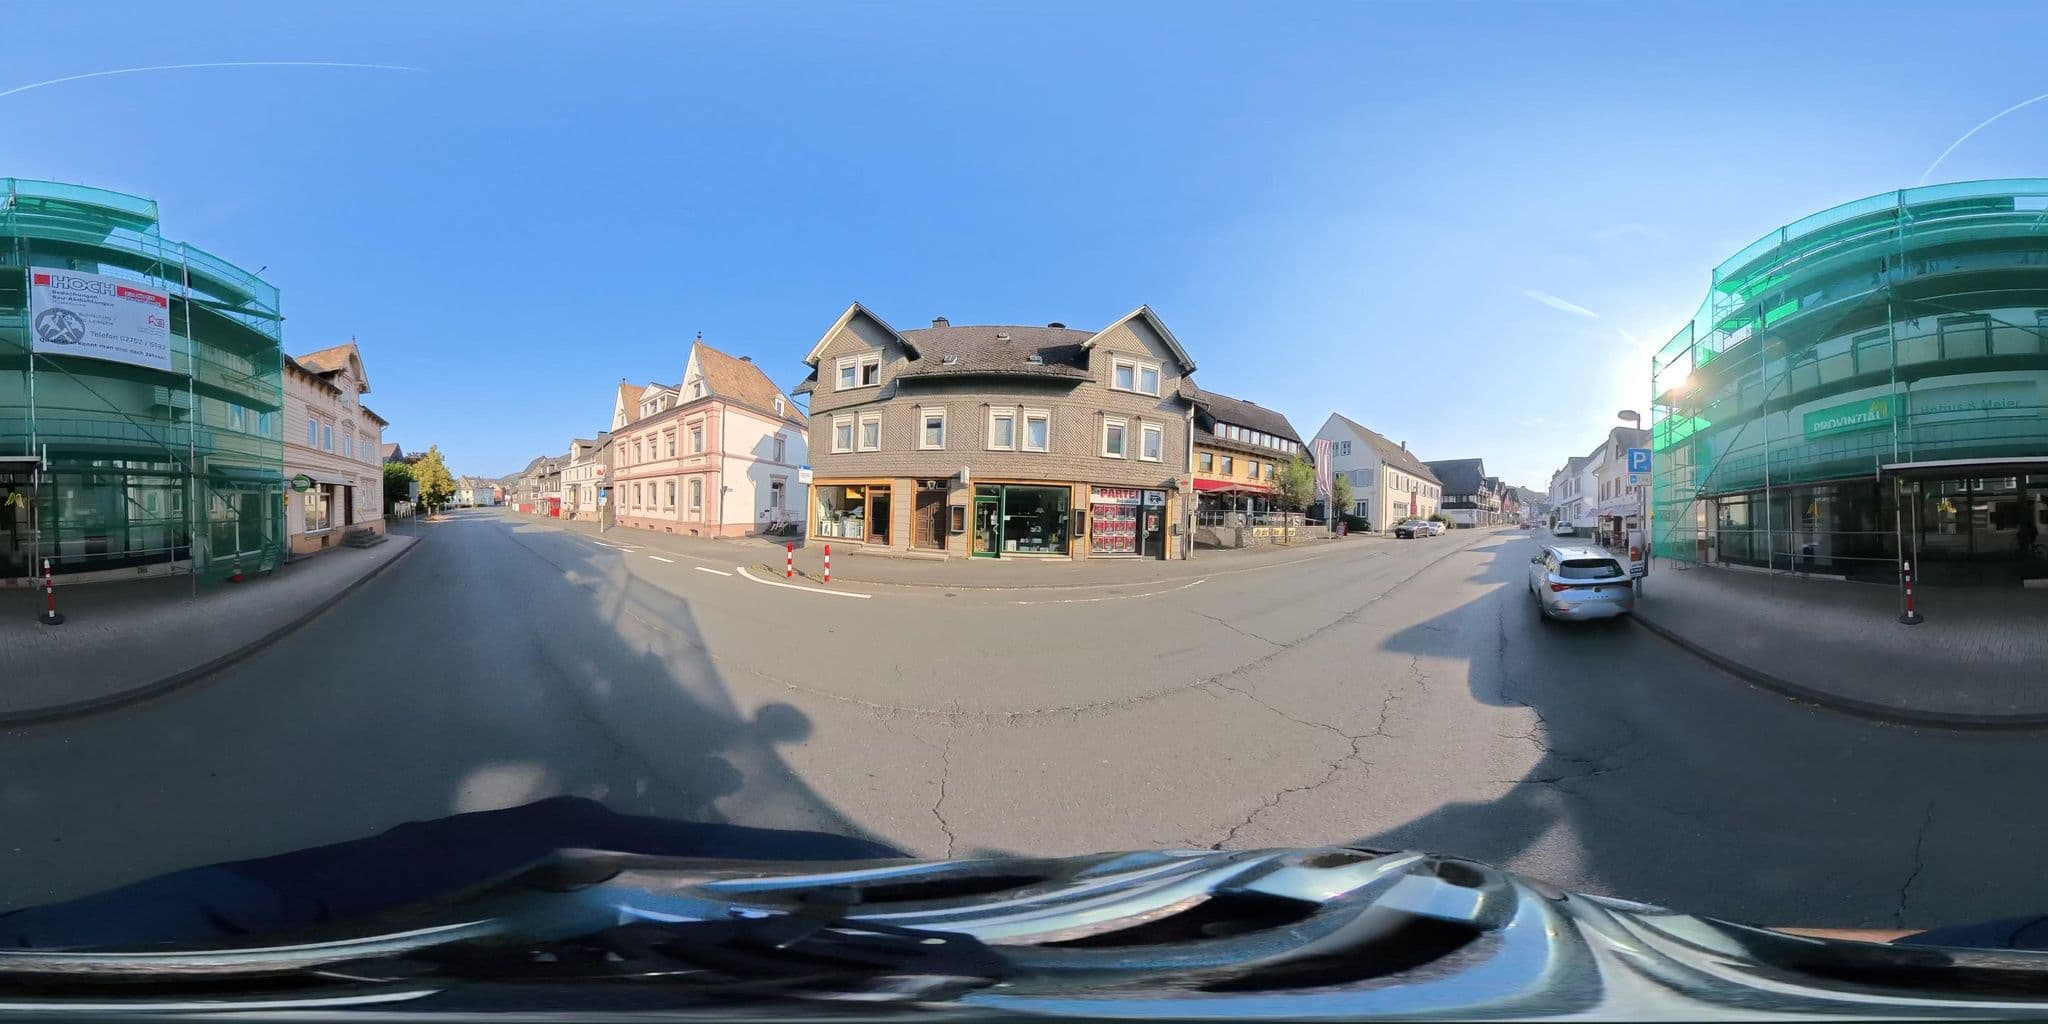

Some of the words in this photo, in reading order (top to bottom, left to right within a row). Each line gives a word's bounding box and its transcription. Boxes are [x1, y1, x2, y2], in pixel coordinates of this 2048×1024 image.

[51, 275, 116, 297] HOCH
[90, 331, 118, 340] Telefon
[1813, 410, 1880, 432] PROVINZIAL
[1633, 451, 1646, 470] P
[1100, 488, 1139, 499] PARTEI
